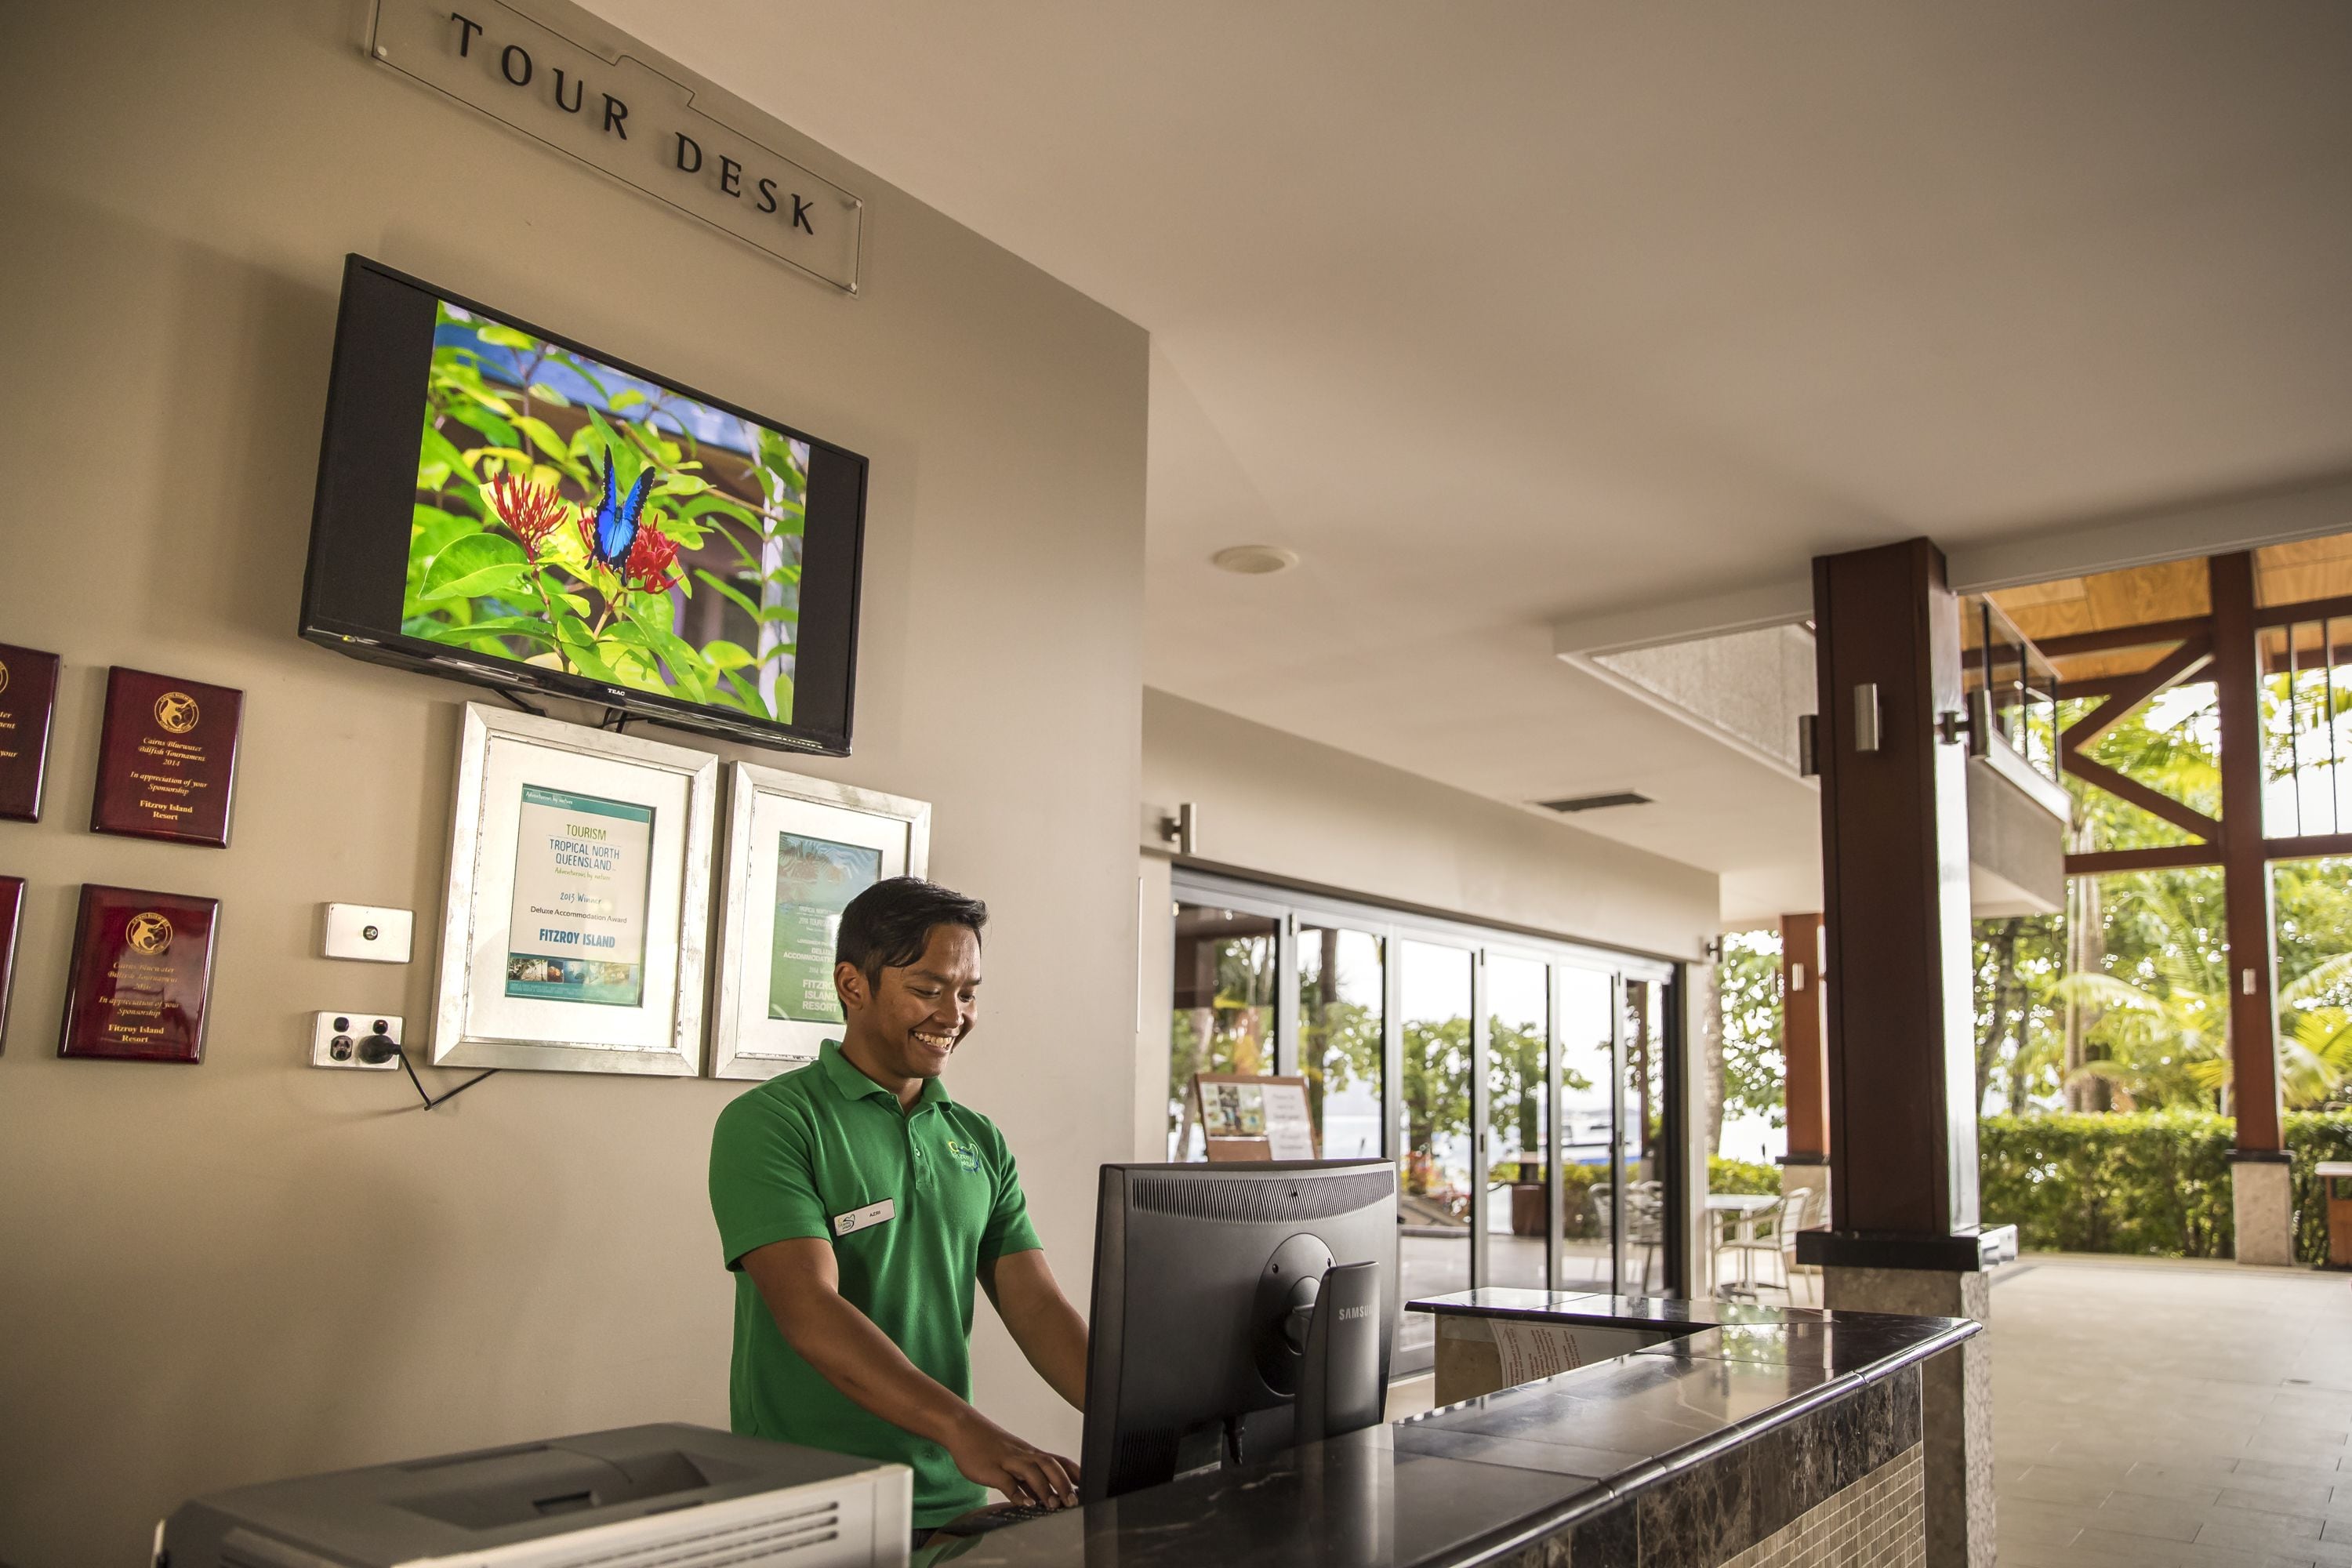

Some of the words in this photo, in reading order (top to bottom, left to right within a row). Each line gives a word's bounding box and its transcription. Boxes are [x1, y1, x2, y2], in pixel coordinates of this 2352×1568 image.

[451, 13, 629, 141] TOUR
[675, 132, 815, 235] DESK
[608, 688, 626, 696] TEAC
[143, 737, 165, 746] Cairns
[167, 741, 201, 752] Bluewater
[138, 746, 165, 755] Billfish
[165, 750, 205, 761] Tournament
[163, 758, 180, 767] 2014
[140, 773, 182, 785] appreciation
[148, 783, 189, 796] Sponsorship
[140, 800, 167, 811] Fitzroy
[169, 804, 193, 813] Island
[153, 811, 178, 820] Resort
[566, 824, 607, 841] TOURISM
[550, 839, 589, 855] TROPICAL
[592, 845, 620, 859] NORTH
[555, 853, 612, 870] QUEENSLAND
[554, 866, 586, 878] Adventurous
[586, 871, 593, 880] by
[530, 906, 554, 915] Deluxe
[554, 909, 607, 921] Accommodation
[607, 915, 627, 924] Award
[539, 928, 580, 945] FITZROY
[583, 933, 615, 948] ISLAND
[784, 952, 835, 963] ACCOMMODATIO
[802, 978, 835, 990] FITZRO
[804, 990, 837, 1001] ISLAND
[117, 1007, 161, 1018] Sponsorship
[802, 1000, 837, 1012] RESORT
[108, 1023, 136, 1034] Fitzroy
